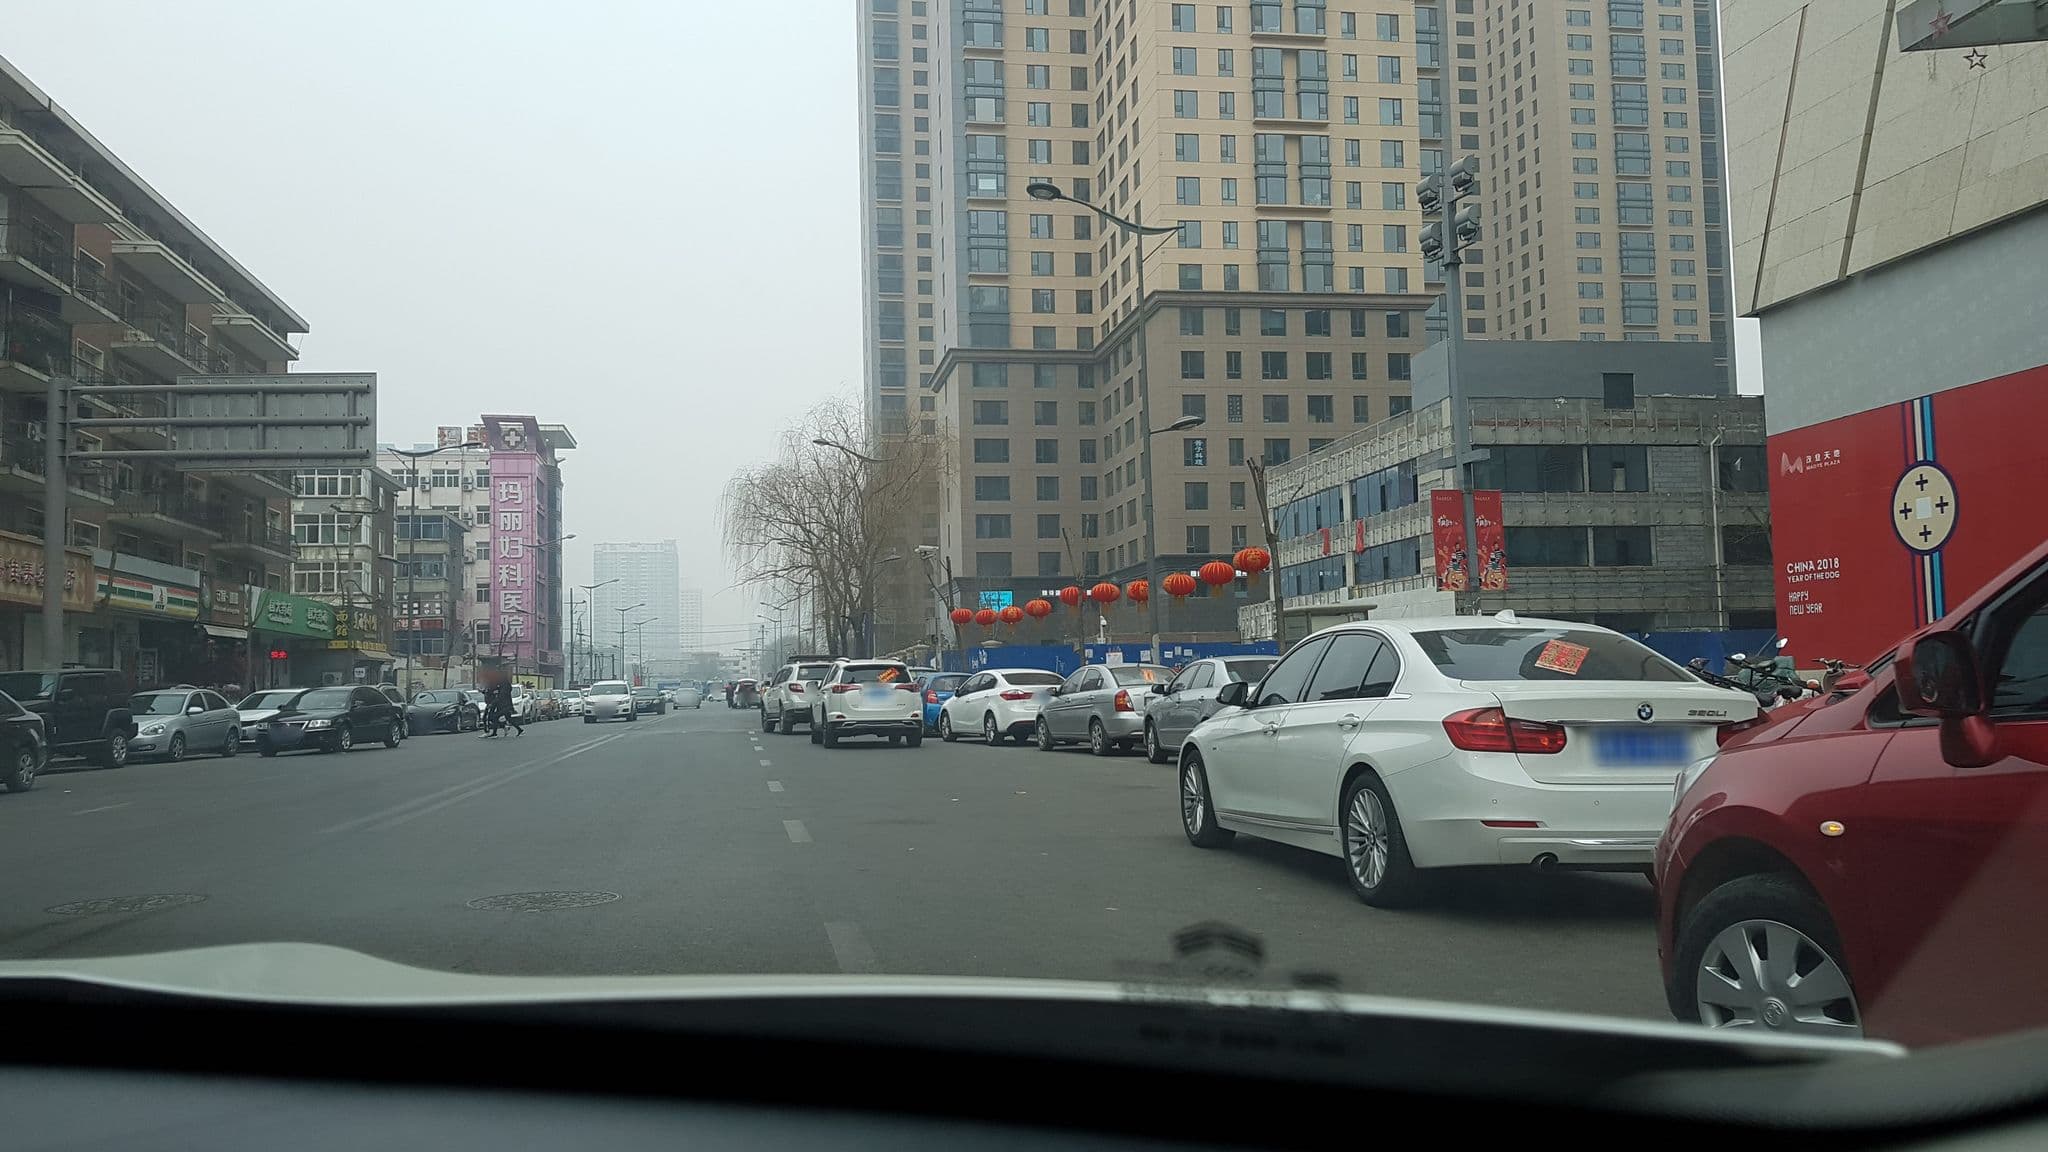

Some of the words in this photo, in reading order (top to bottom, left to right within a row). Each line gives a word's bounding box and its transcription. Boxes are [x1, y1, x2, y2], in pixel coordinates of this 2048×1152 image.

[499, 481, 524, 638] 玛丽妇科医院
[1786, 560, 1815, 574] CHINA
[1817, 557, 1840, 570] 2018
[1787, 574, 1804, 584] YEAR
[1804, 573, 1812, 581] OF
[1813, 572, 1824, 580] THE
[1825, 570, 1840, 579] DOG
[1788, 590, 1809, 602] HAPPY
[1806, 602, 1823, 614] YEAR
